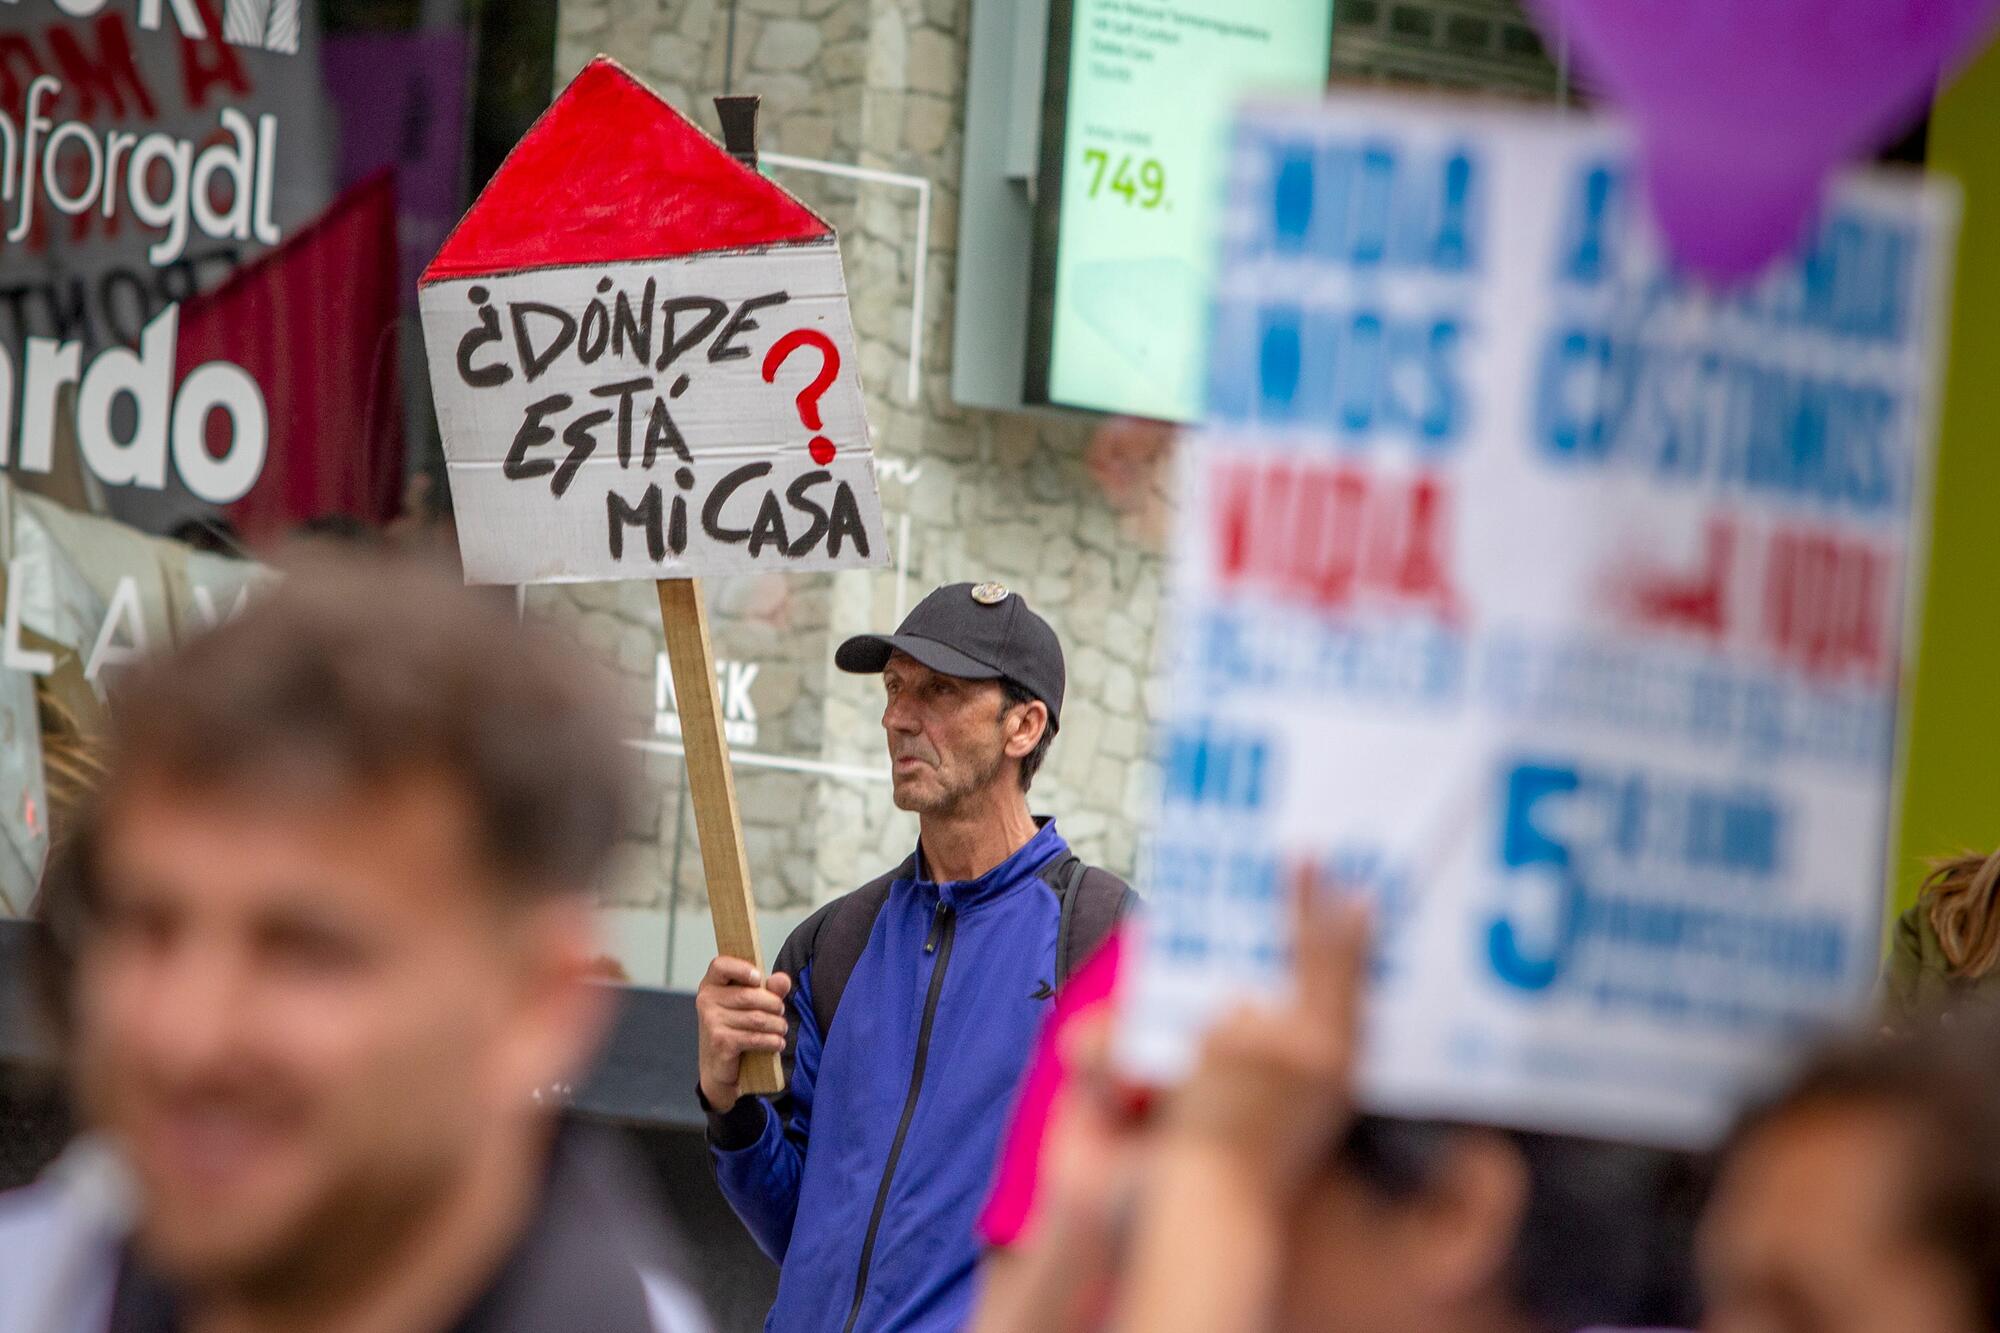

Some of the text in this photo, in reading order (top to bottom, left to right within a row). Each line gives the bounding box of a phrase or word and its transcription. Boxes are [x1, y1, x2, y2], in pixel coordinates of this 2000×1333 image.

[457, 276, 790, 387] ¿DÓNDE
[0, 301, 269, 504] rdo
[503, 374, 694, 498] ESTÁ
[701, 461, 870, 559] CASA
[1487, 763, 1588, 990] 5
